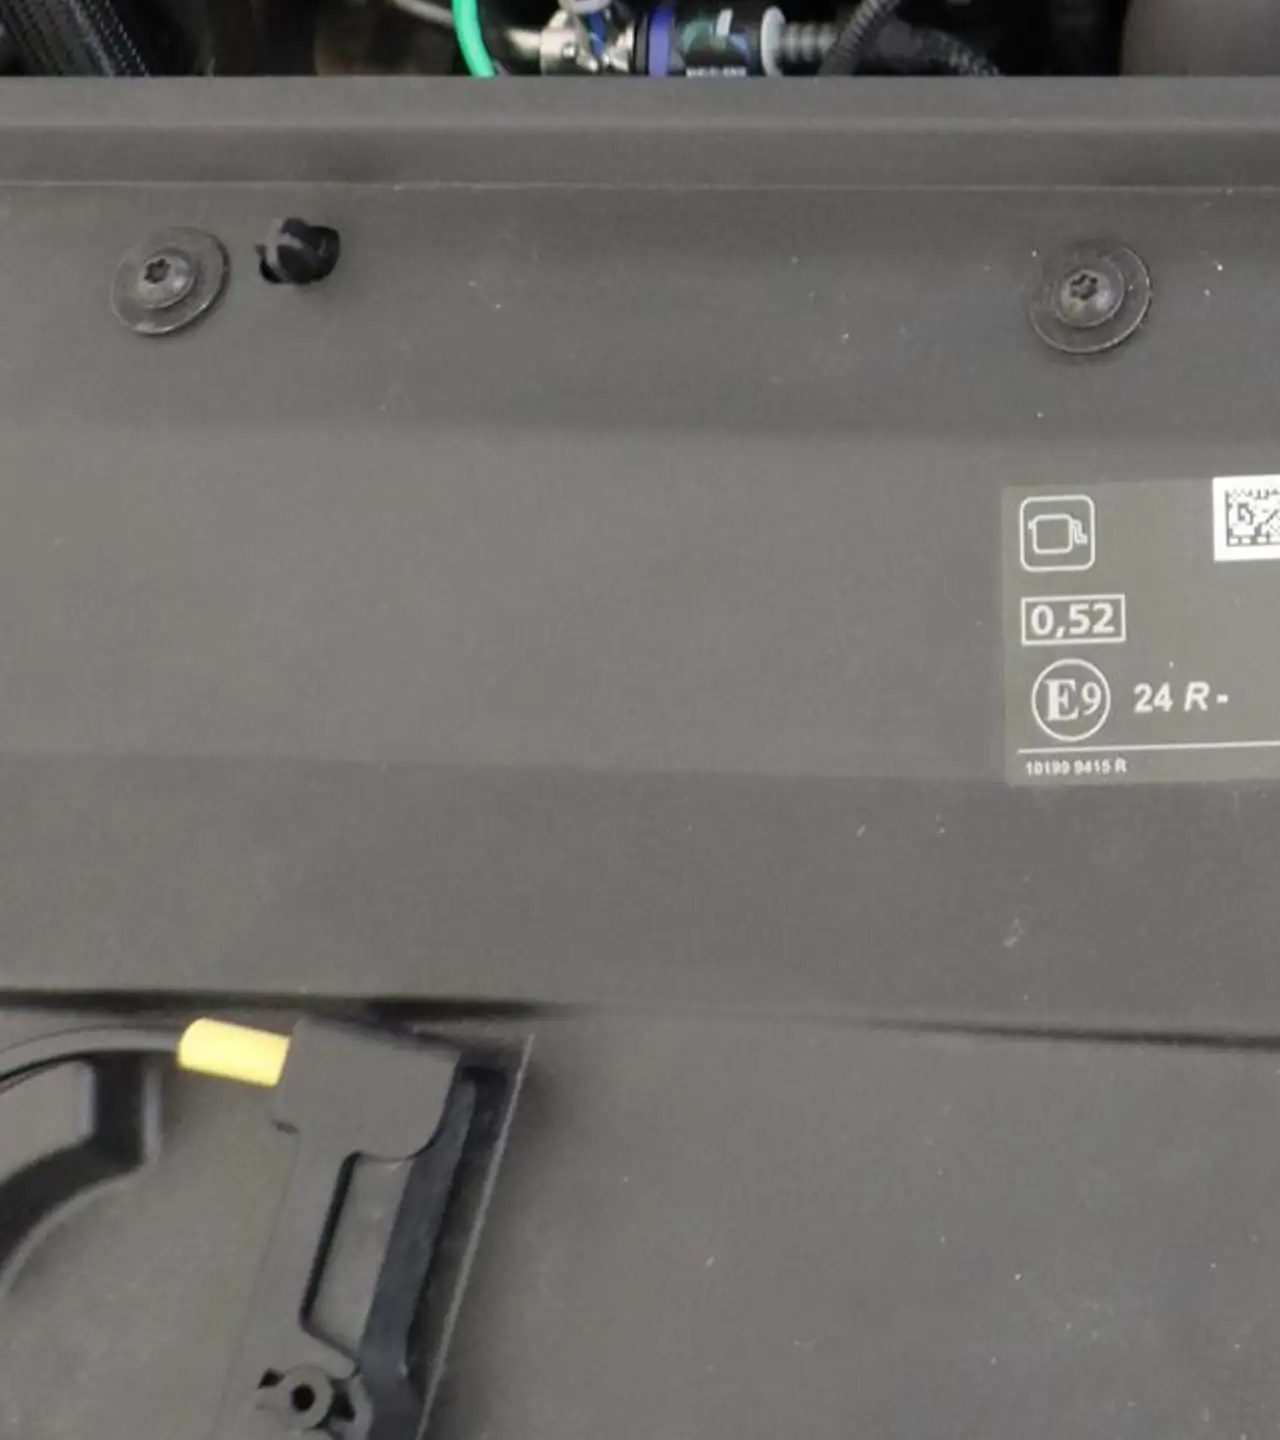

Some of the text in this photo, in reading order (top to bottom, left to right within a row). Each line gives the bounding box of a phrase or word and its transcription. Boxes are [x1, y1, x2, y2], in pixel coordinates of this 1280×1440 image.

[1030, 602, 1115, 639] 0,52
[1043, 677, 1102, 722] E9
[1132, 682, 1174, 713] 24
